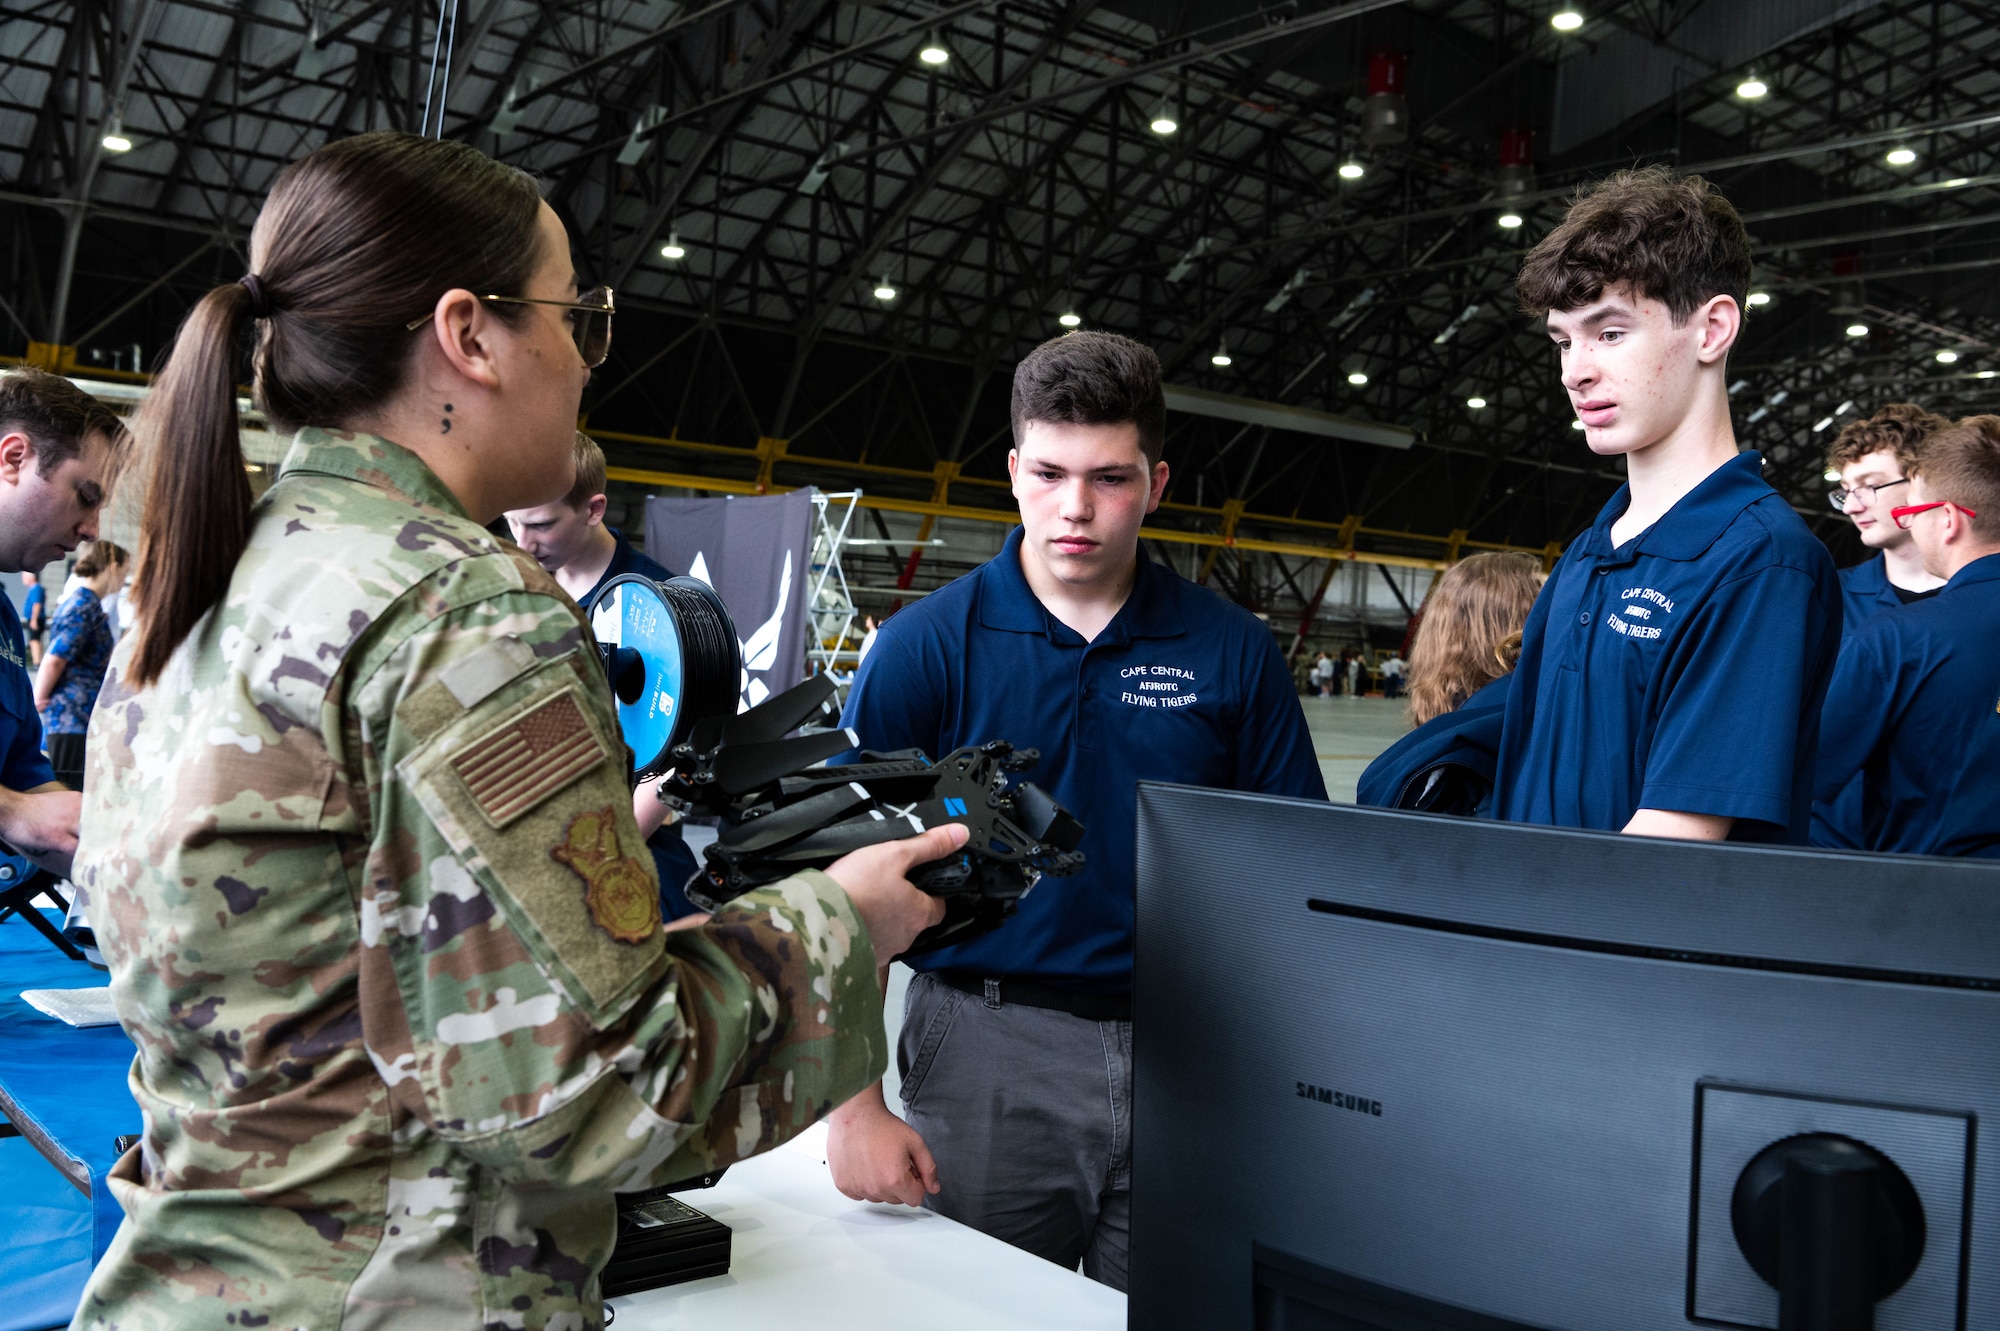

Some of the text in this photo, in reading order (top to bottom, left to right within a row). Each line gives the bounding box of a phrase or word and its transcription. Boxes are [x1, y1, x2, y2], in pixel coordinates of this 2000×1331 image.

[1621, 588, 1674, 613] CAPE CENTRAL
[1607, 613, 1662, 639] FLYING TIGERS
[1120, 666, 1195, 680] CAPE CENTRAL
[1139, 681, 1178, 691] AFJROTC
[649, 690, 659, 719] BUILD
[1121, 692, 1197, 707] FLYING TIGERS
[1296, 1081, 1382, 1117] SAMSUNG
